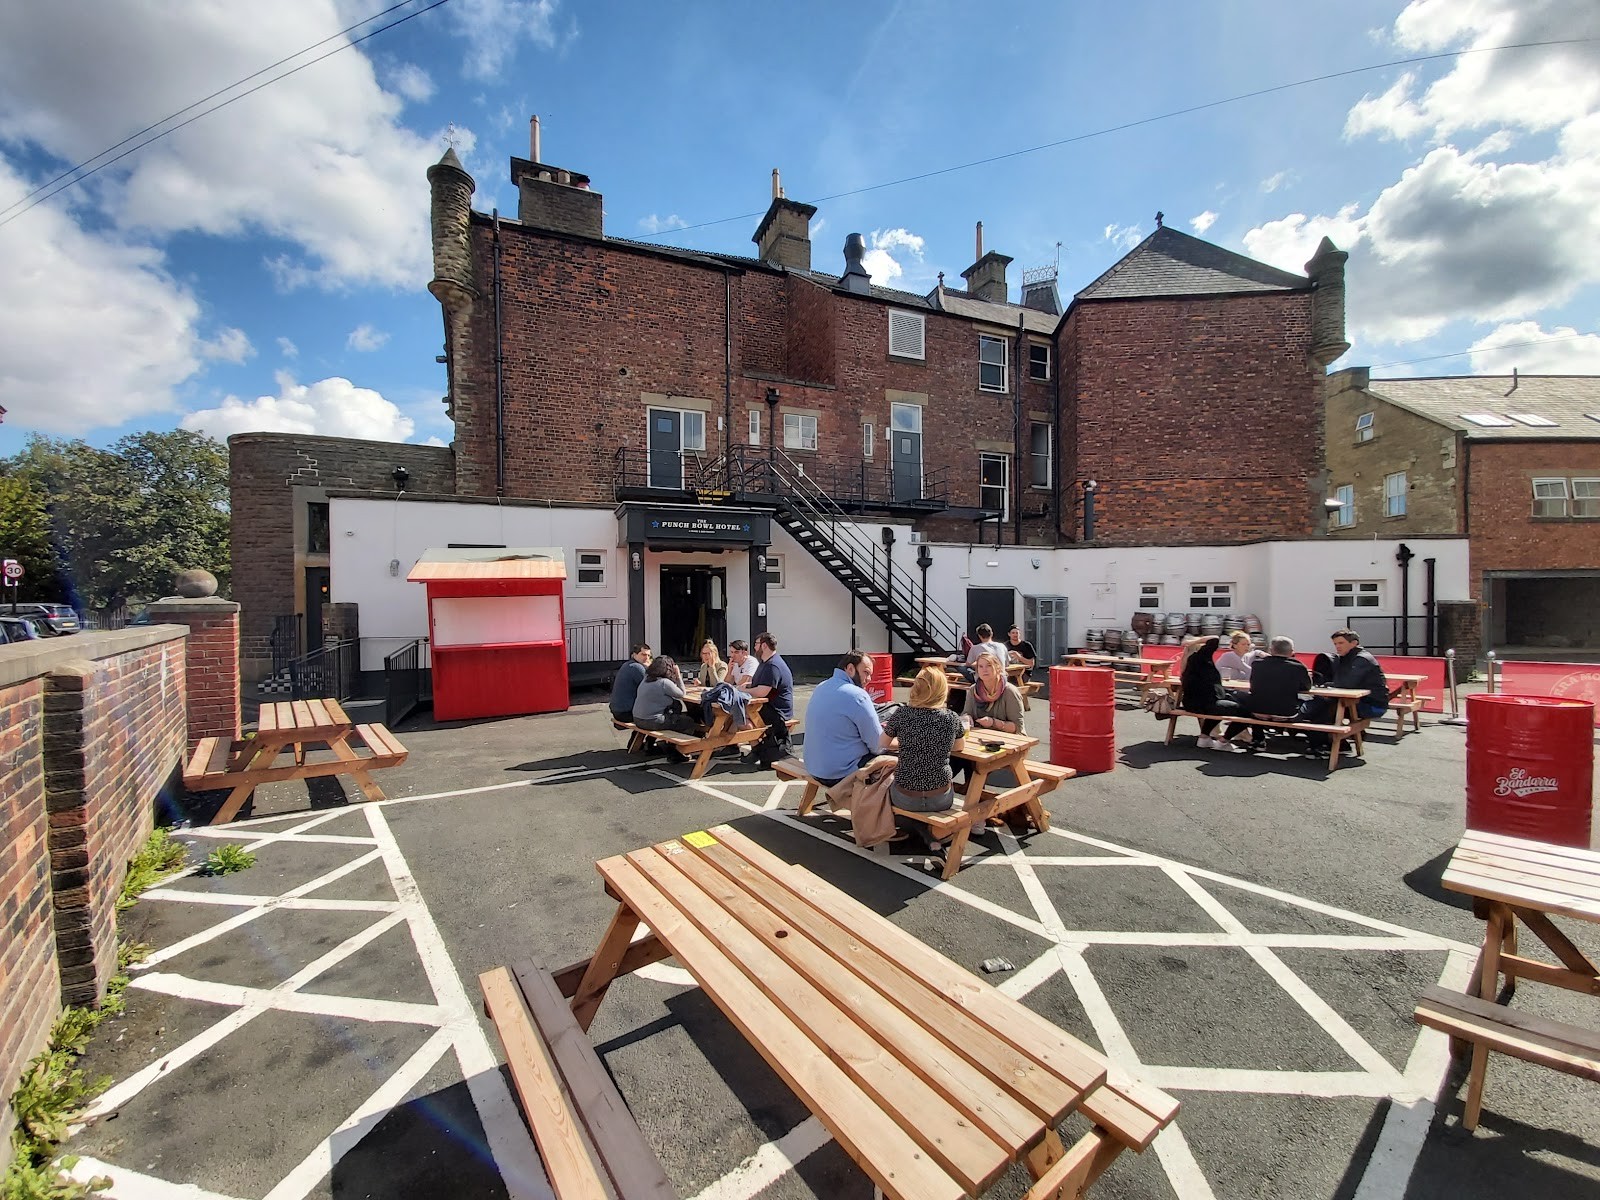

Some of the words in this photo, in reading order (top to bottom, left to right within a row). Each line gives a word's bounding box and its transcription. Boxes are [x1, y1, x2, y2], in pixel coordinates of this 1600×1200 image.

[7, 567, 21, 575] 30
[1509, 767, 1526, 780] El
[1493, 775, 1559, 796] Bandarra
